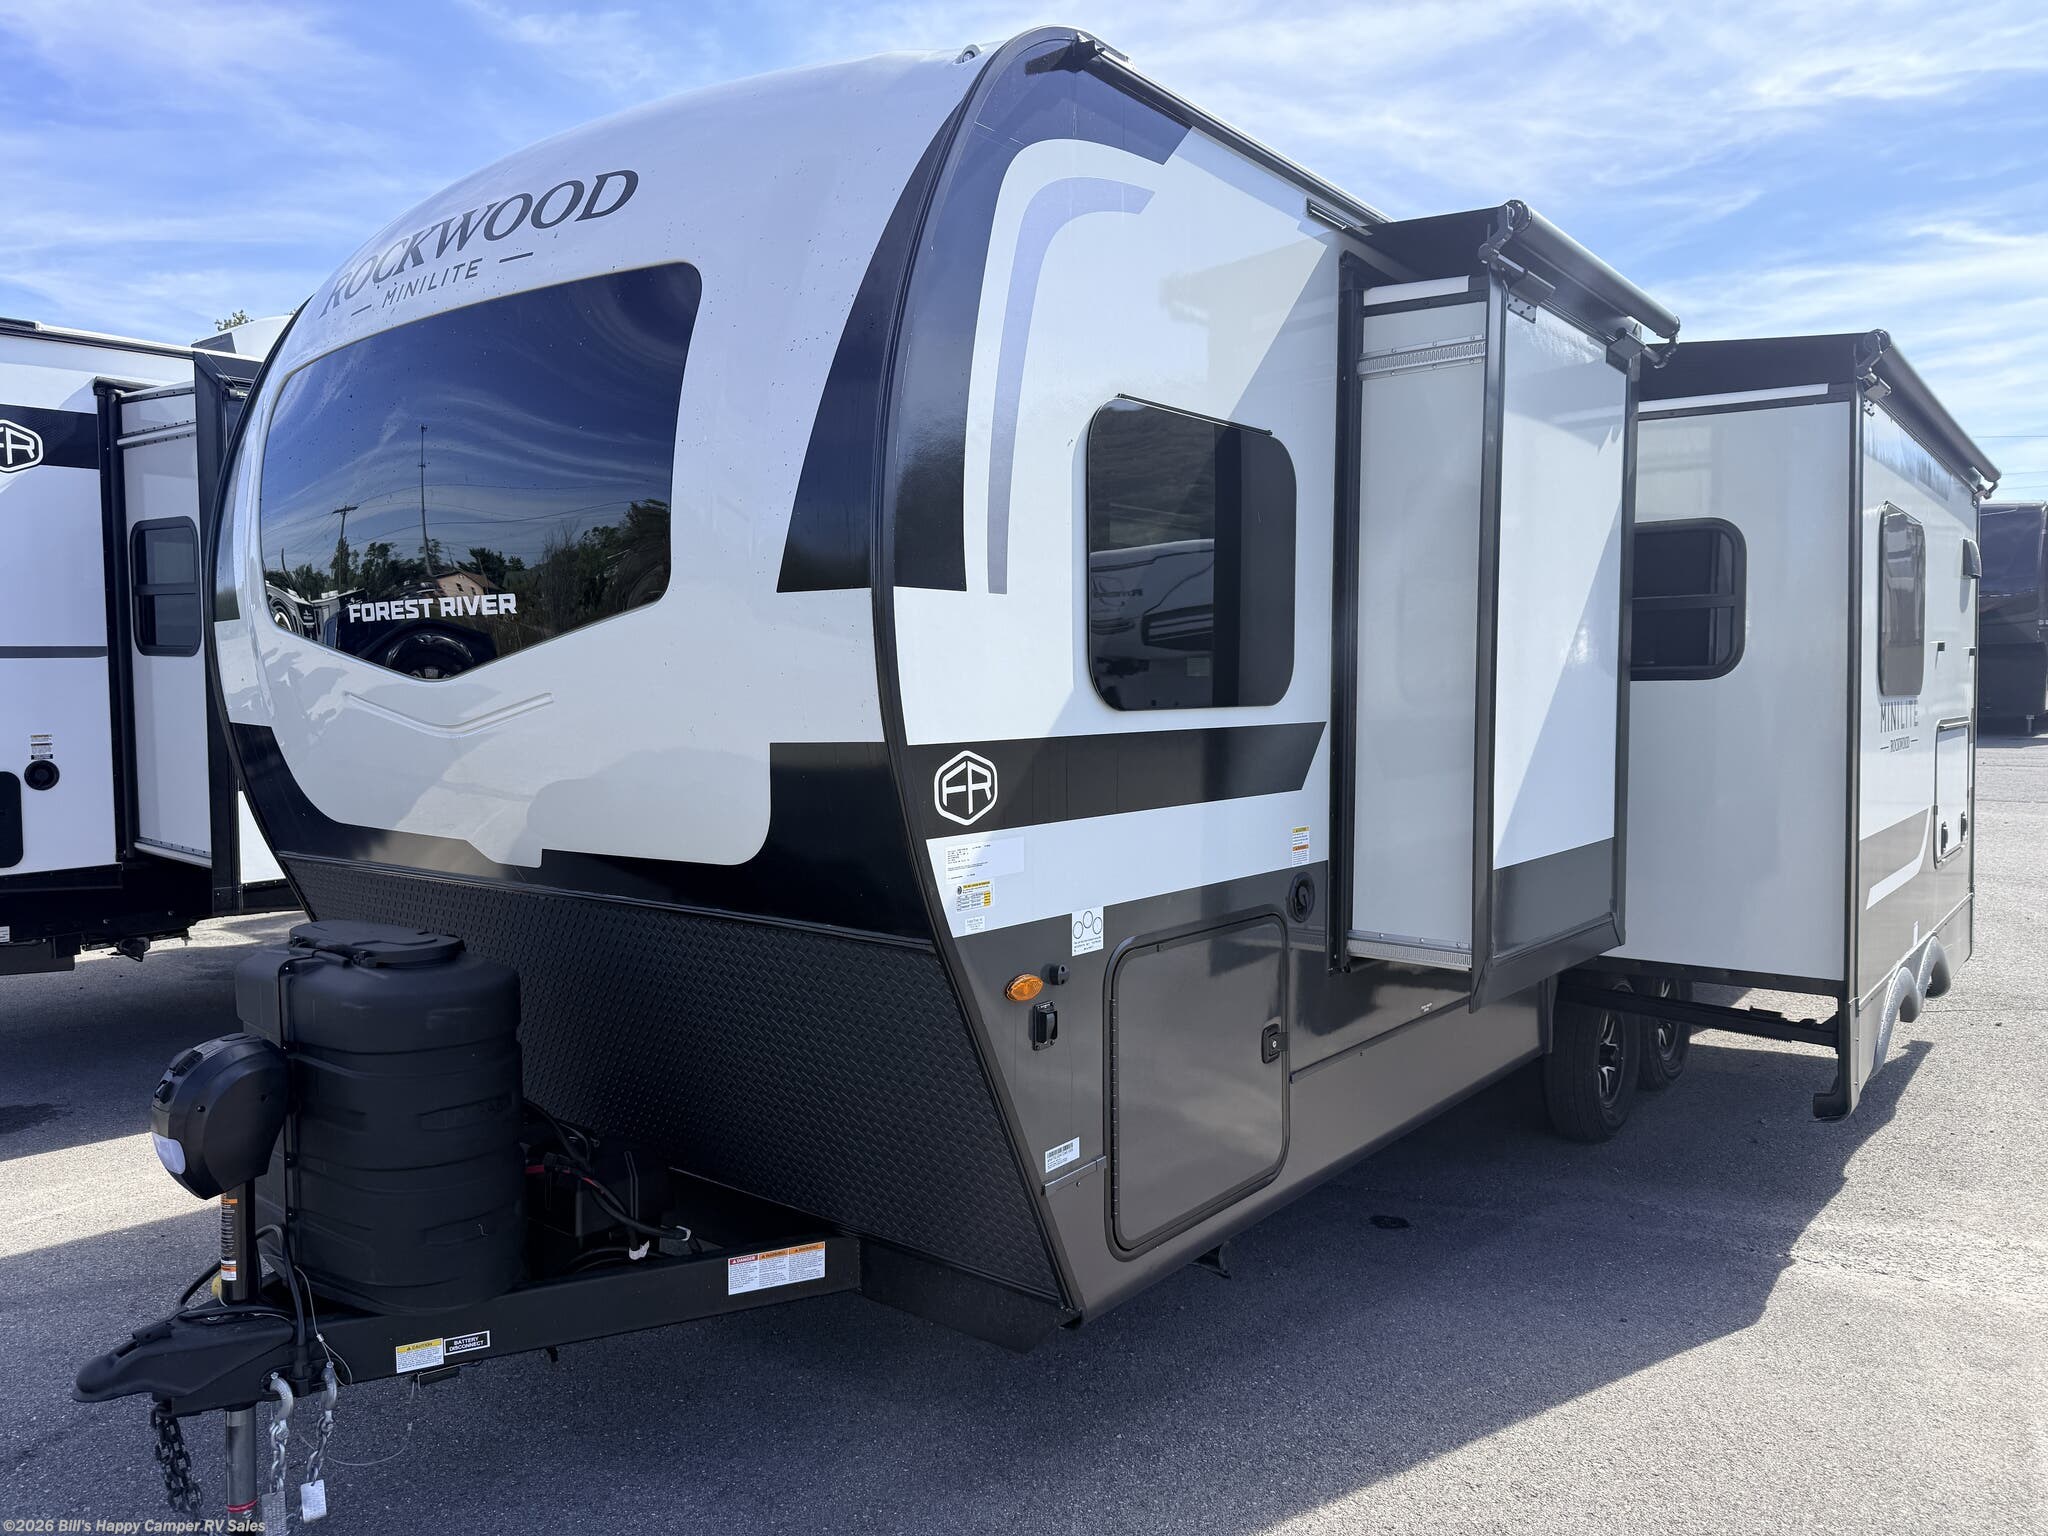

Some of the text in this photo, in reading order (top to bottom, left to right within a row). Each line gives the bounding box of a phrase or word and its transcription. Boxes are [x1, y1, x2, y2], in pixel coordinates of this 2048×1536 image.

[318, 169, 639, 320] ROCKWOOD
[382, 258, 483, 308] MINILITE
[348, 593, 518, 623] FOREST RIVER
[1880, 699, 1919, 733] MINILITE
[449, 1340, 484, 1352] DISCONNECT
[453, 1336, 479, 1346] BATTERY
